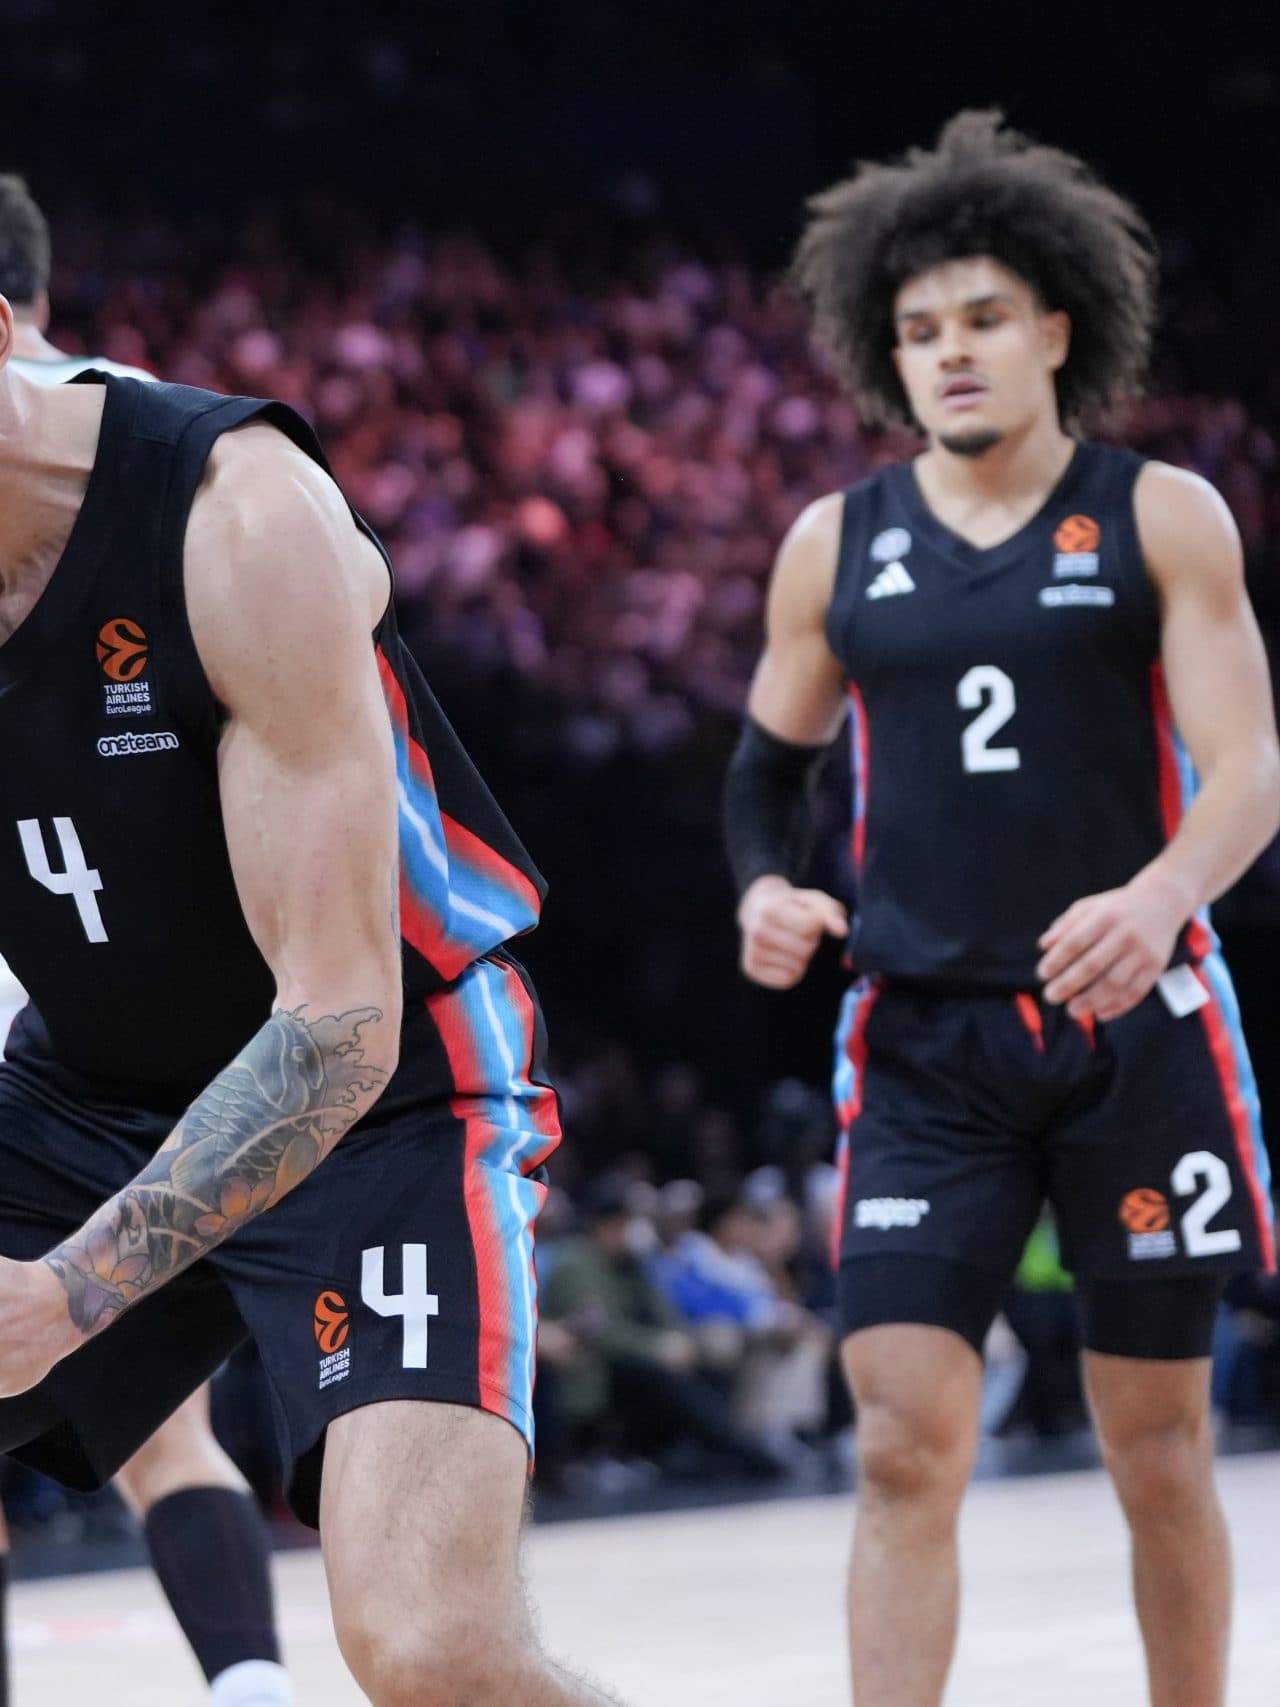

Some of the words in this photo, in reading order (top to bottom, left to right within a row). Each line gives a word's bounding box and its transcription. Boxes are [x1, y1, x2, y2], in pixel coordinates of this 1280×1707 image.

[104, 682, 149, 694] TURKISH
[106, 693, 150, 705] AIRLINES
[106, 704, 152, 715] EuroLeague
[958, 666, 1021, 773] 2
[98, 731, 180, 756] oneteam
[17, 817, 109, 944] 4
[1171, 1150, 1242, 1257] 2
[361, 1244, 440, 1369] 4
[319, 1347, 350, 1370] TURKISH
[319, 1358, 350, 1380] AIRLINES
